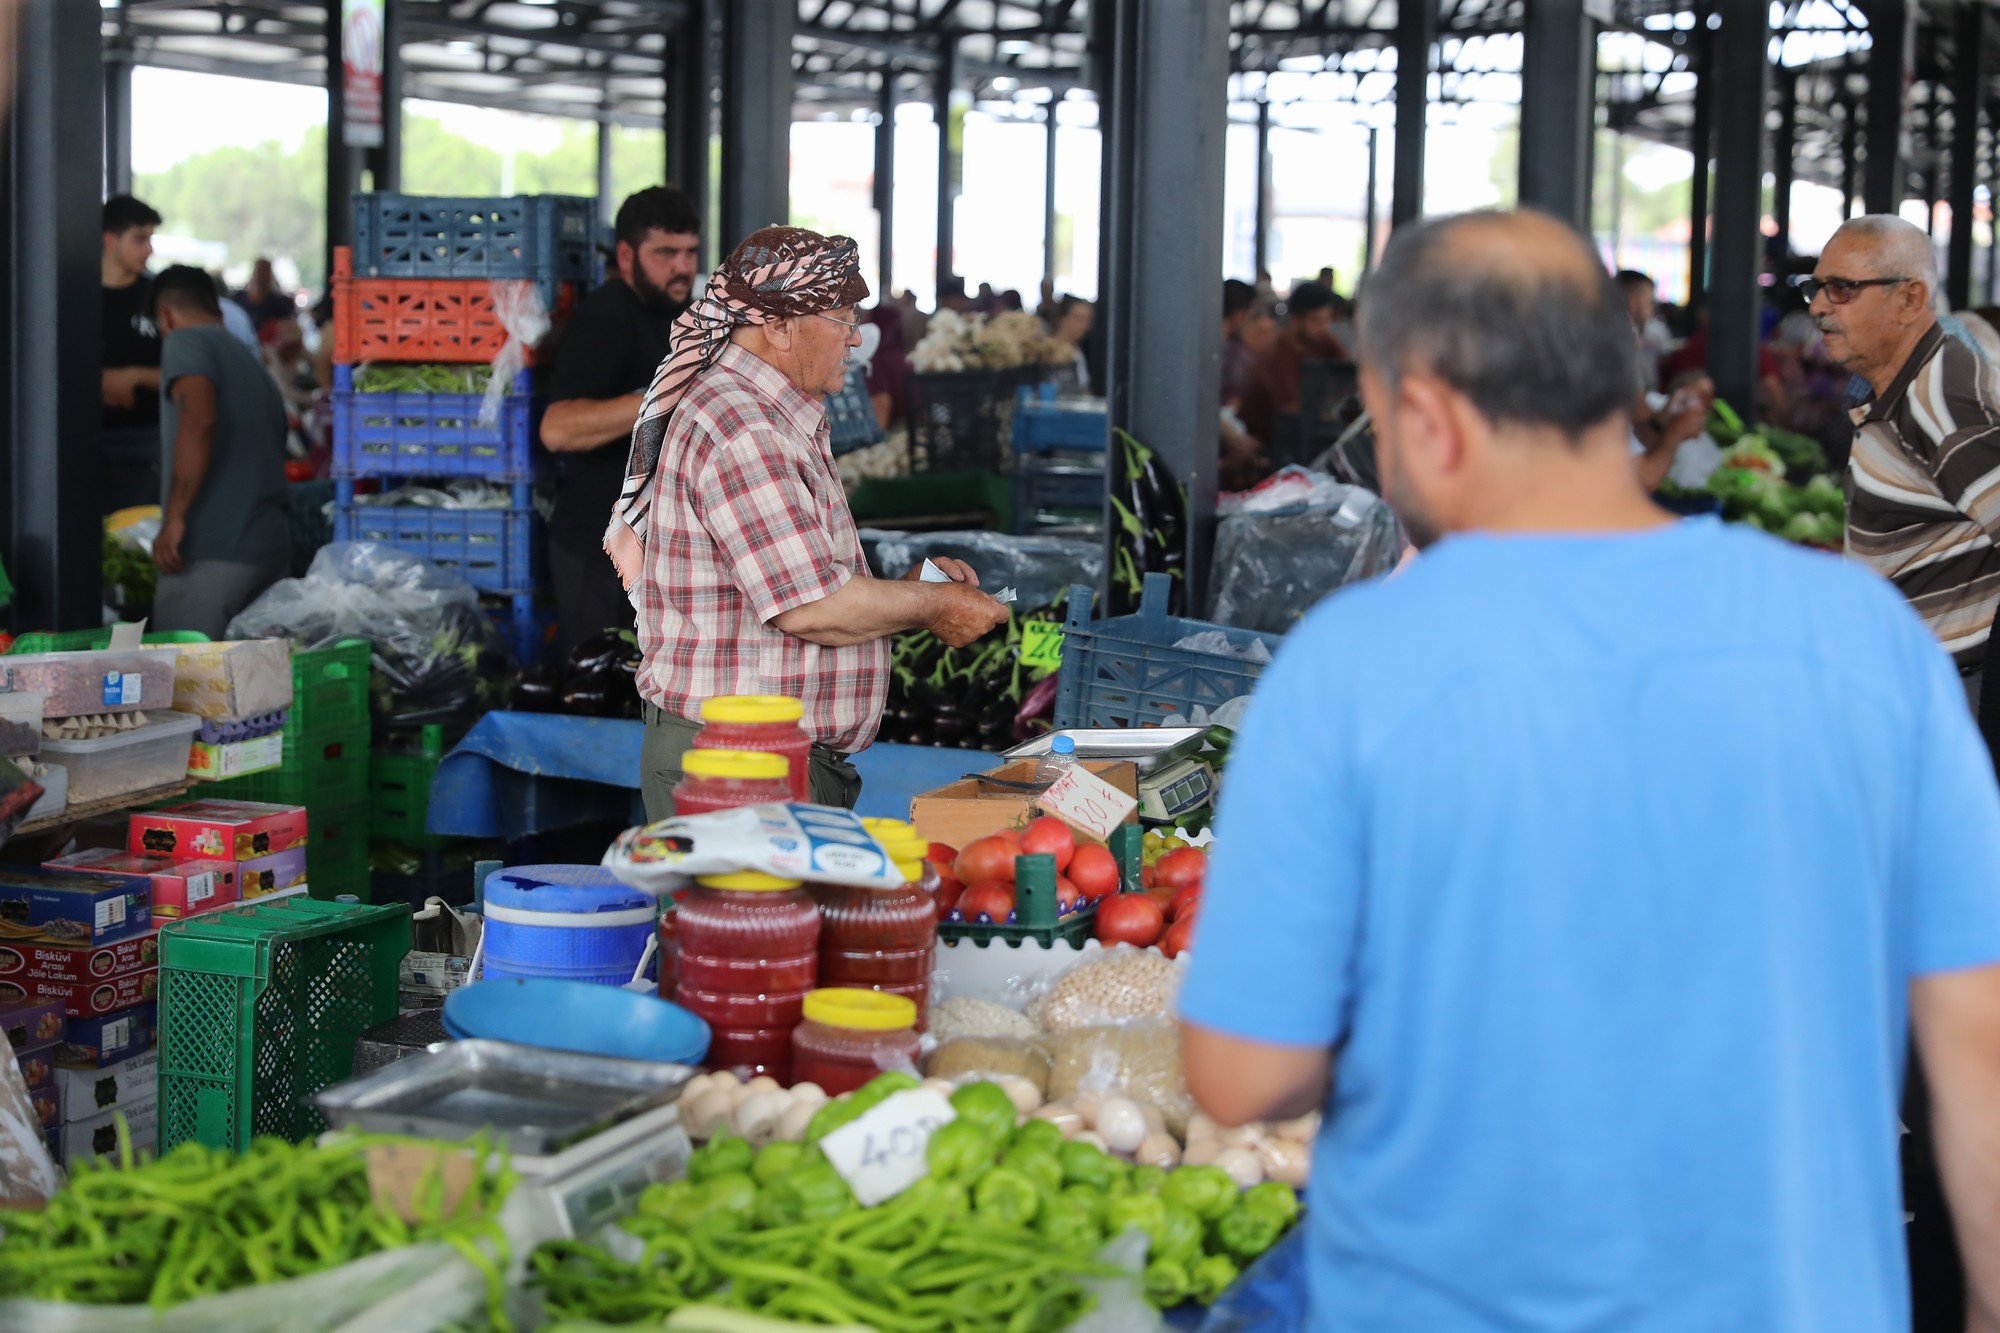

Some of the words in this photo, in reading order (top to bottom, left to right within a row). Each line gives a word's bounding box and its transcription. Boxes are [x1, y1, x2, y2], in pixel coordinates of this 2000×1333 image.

[117, 942, 138, 955] Bisküvi
[34, 949, 71, 962] Bisküvi
[40, 961, 64, 971] Arası
[27, 968, 47, 978] Jöle
[47, 971, 77, 981] Lokum
[118, 976, 139, 990] Bisküvi
[37, 984, 73, 997] Bisküvi
